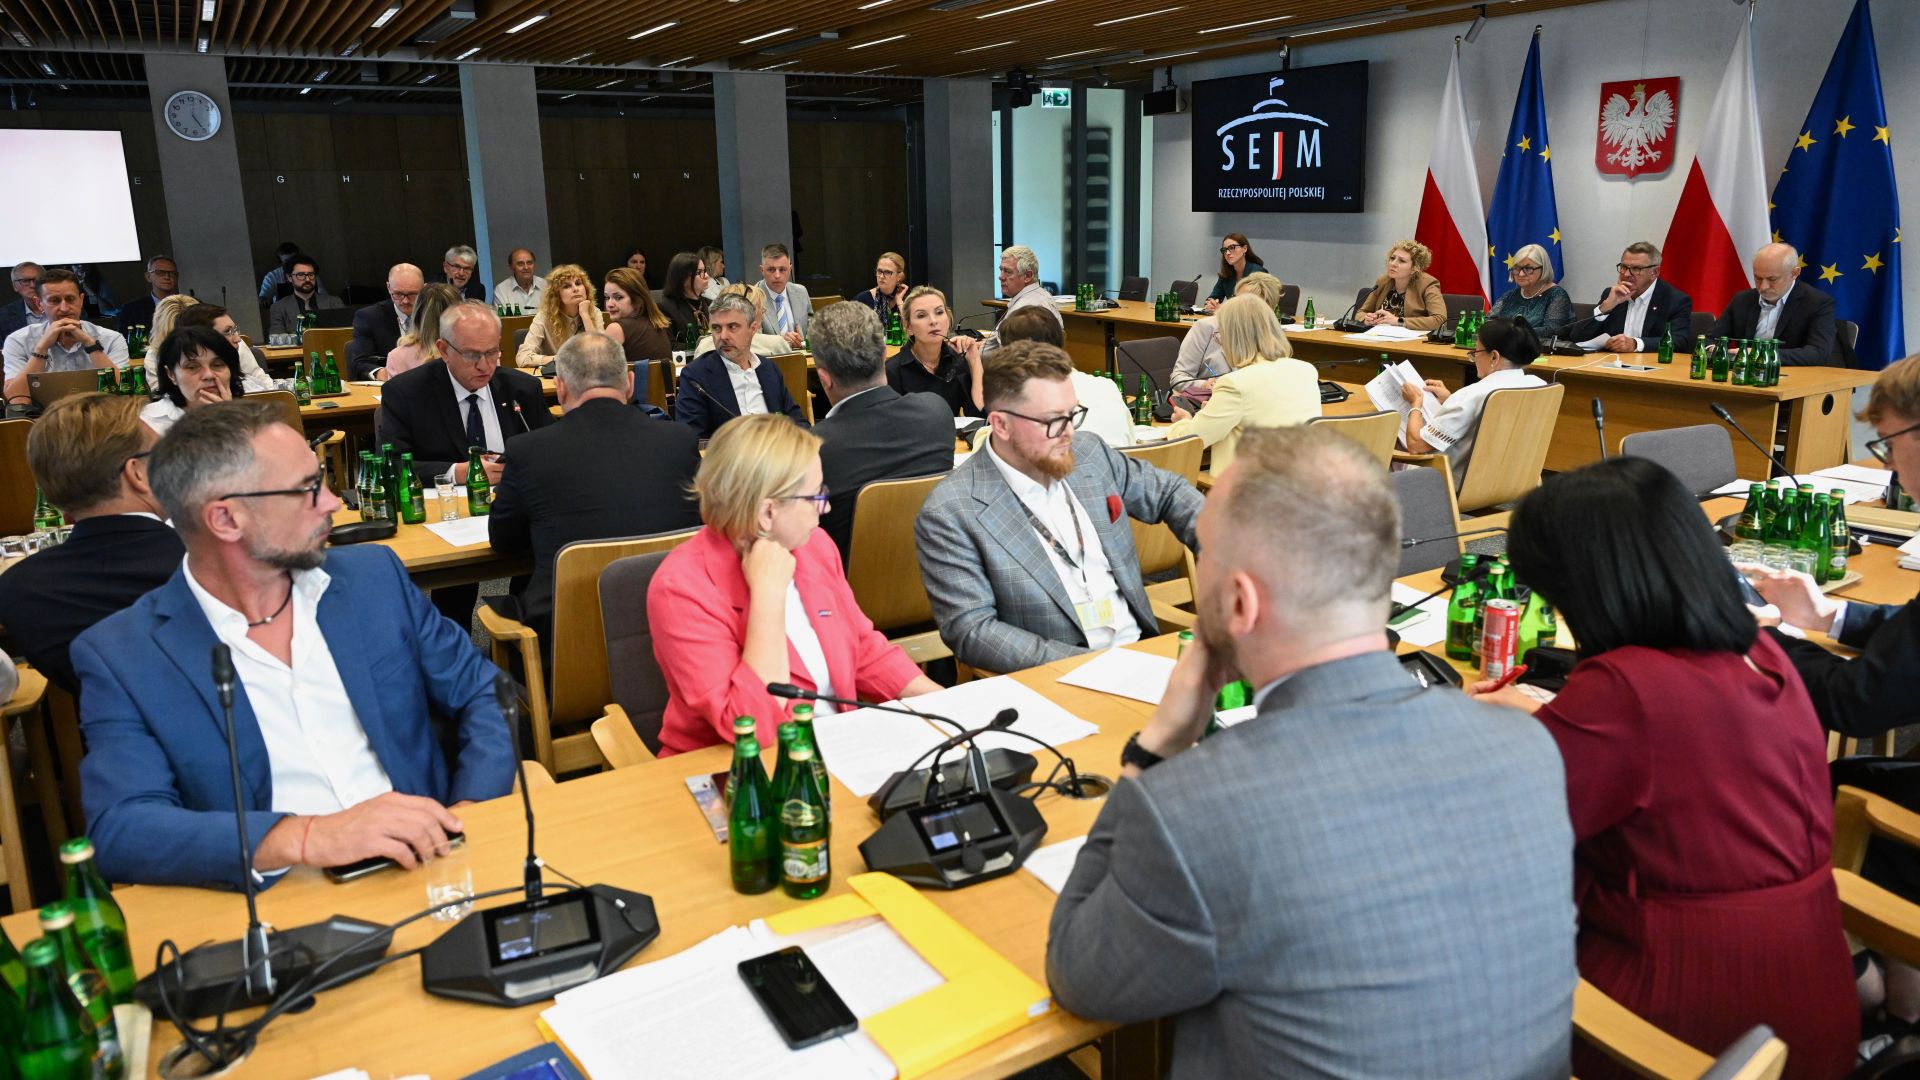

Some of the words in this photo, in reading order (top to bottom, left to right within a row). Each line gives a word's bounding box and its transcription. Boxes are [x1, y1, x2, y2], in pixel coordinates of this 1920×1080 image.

[1222, 129, 1322, 180] SEJM
[135, 177, 142, 185] E
[277, 175, 285, 183] G
[343, 175, 350, 183] H
[1218, 187, 1286, 200] RZECZYPOSPOLITEJ
[1289, 186, 1325, 200] POLSKIEJ
